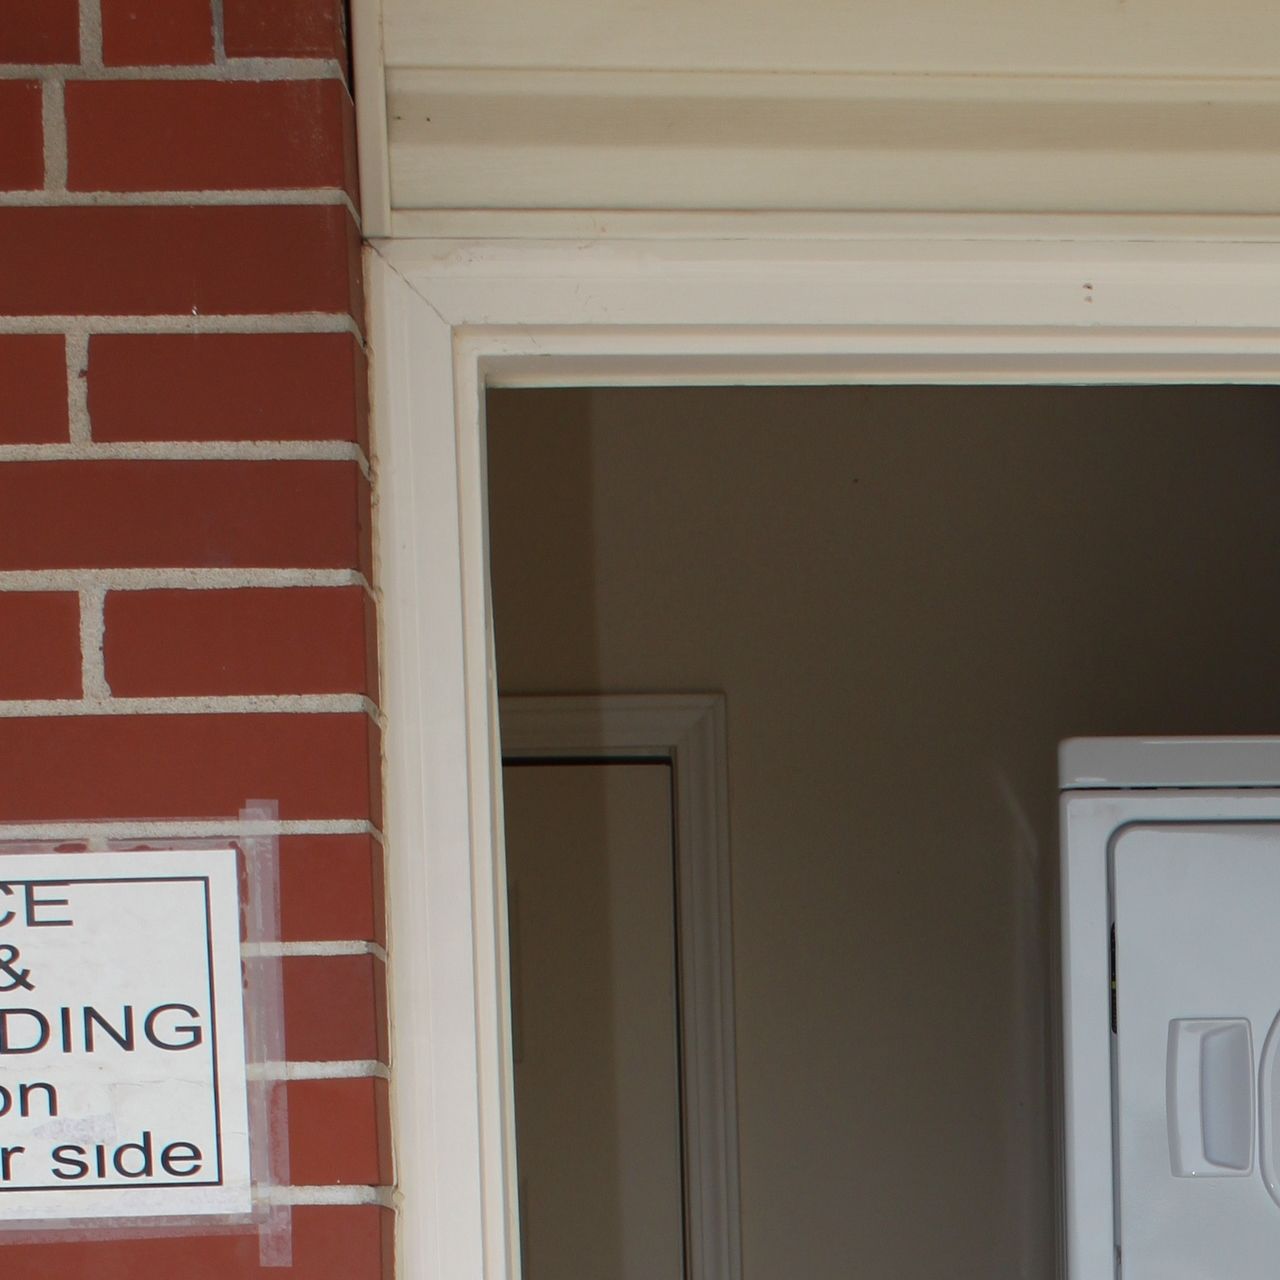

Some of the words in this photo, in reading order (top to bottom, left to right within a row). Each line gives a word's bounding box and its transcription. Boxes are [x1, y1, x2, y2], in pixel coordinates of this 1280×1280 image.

[0, 944, 36, 993] &
[0, 1003, 203, 1055] DING
[52, 1131, 203, 1180] side
